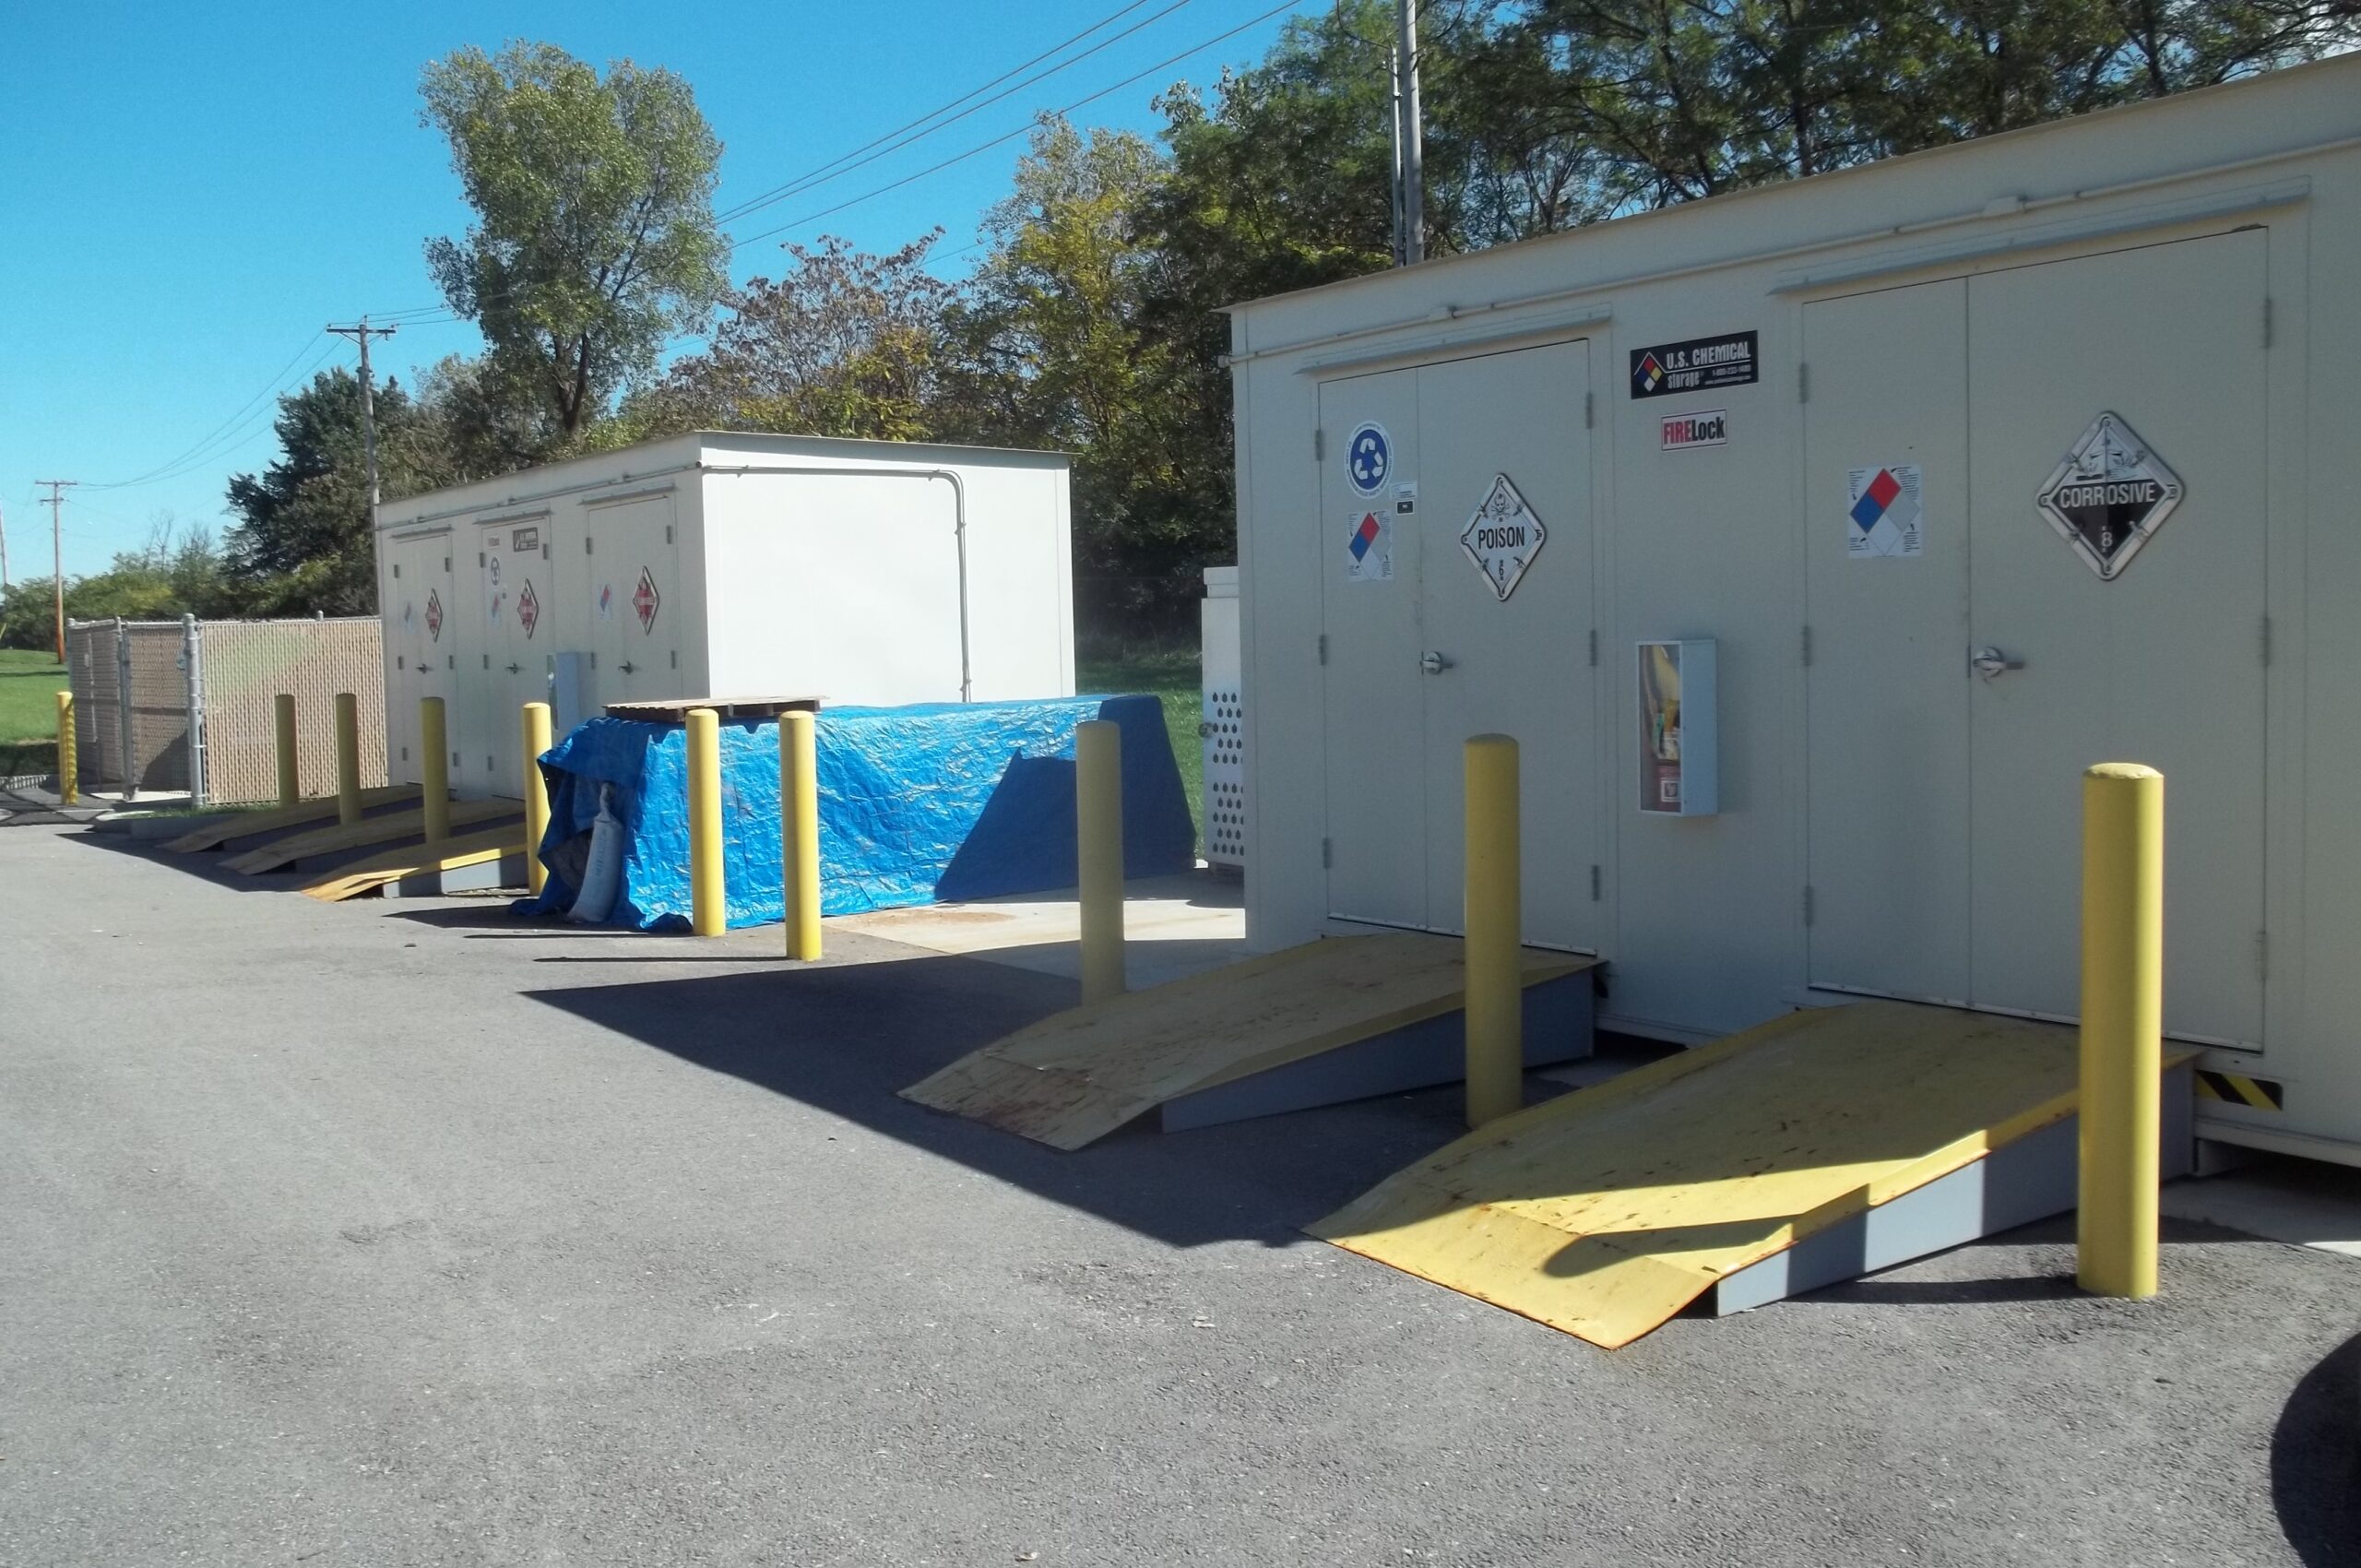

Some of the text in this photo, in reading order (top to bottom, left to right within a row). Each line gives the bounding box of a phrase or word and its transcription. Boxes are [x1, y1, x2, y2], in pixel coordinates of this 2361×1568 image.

[1666, 340, 1751, 370] U.S. CHEMICAL
[2059, 481, 2155, 509] CORROSIVE
[1477, 526, 1525, 550] POISON
[2100, 531, 2113, 548] 8
[1498, 564, 1504, 576] 6
